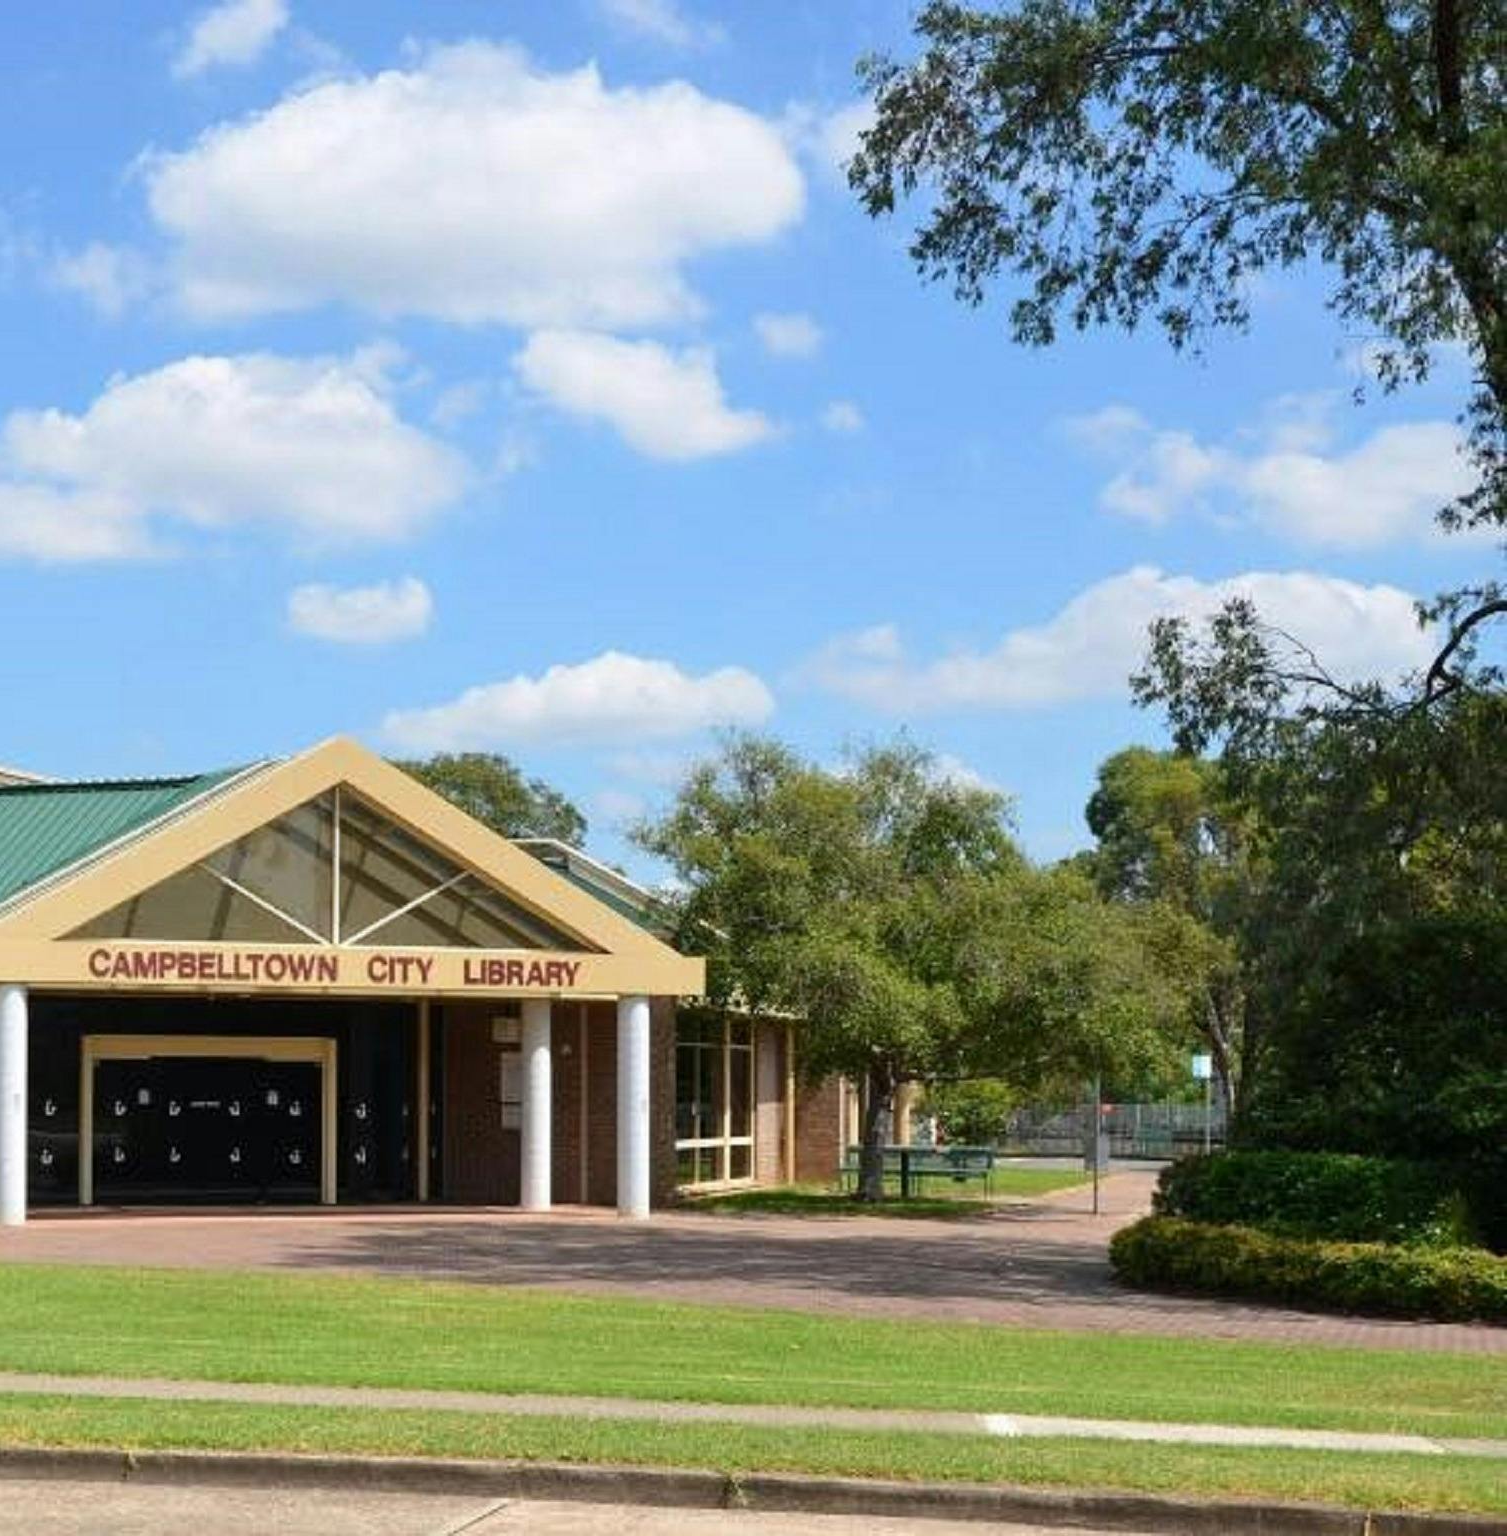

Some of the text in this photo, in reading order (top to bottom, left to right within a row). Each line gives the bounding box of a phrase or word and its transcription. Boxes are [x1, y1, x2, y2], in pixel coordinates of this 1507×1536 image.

[88, 949, 581, 987] CAMPBELLTOWN CITY LIBRARY
